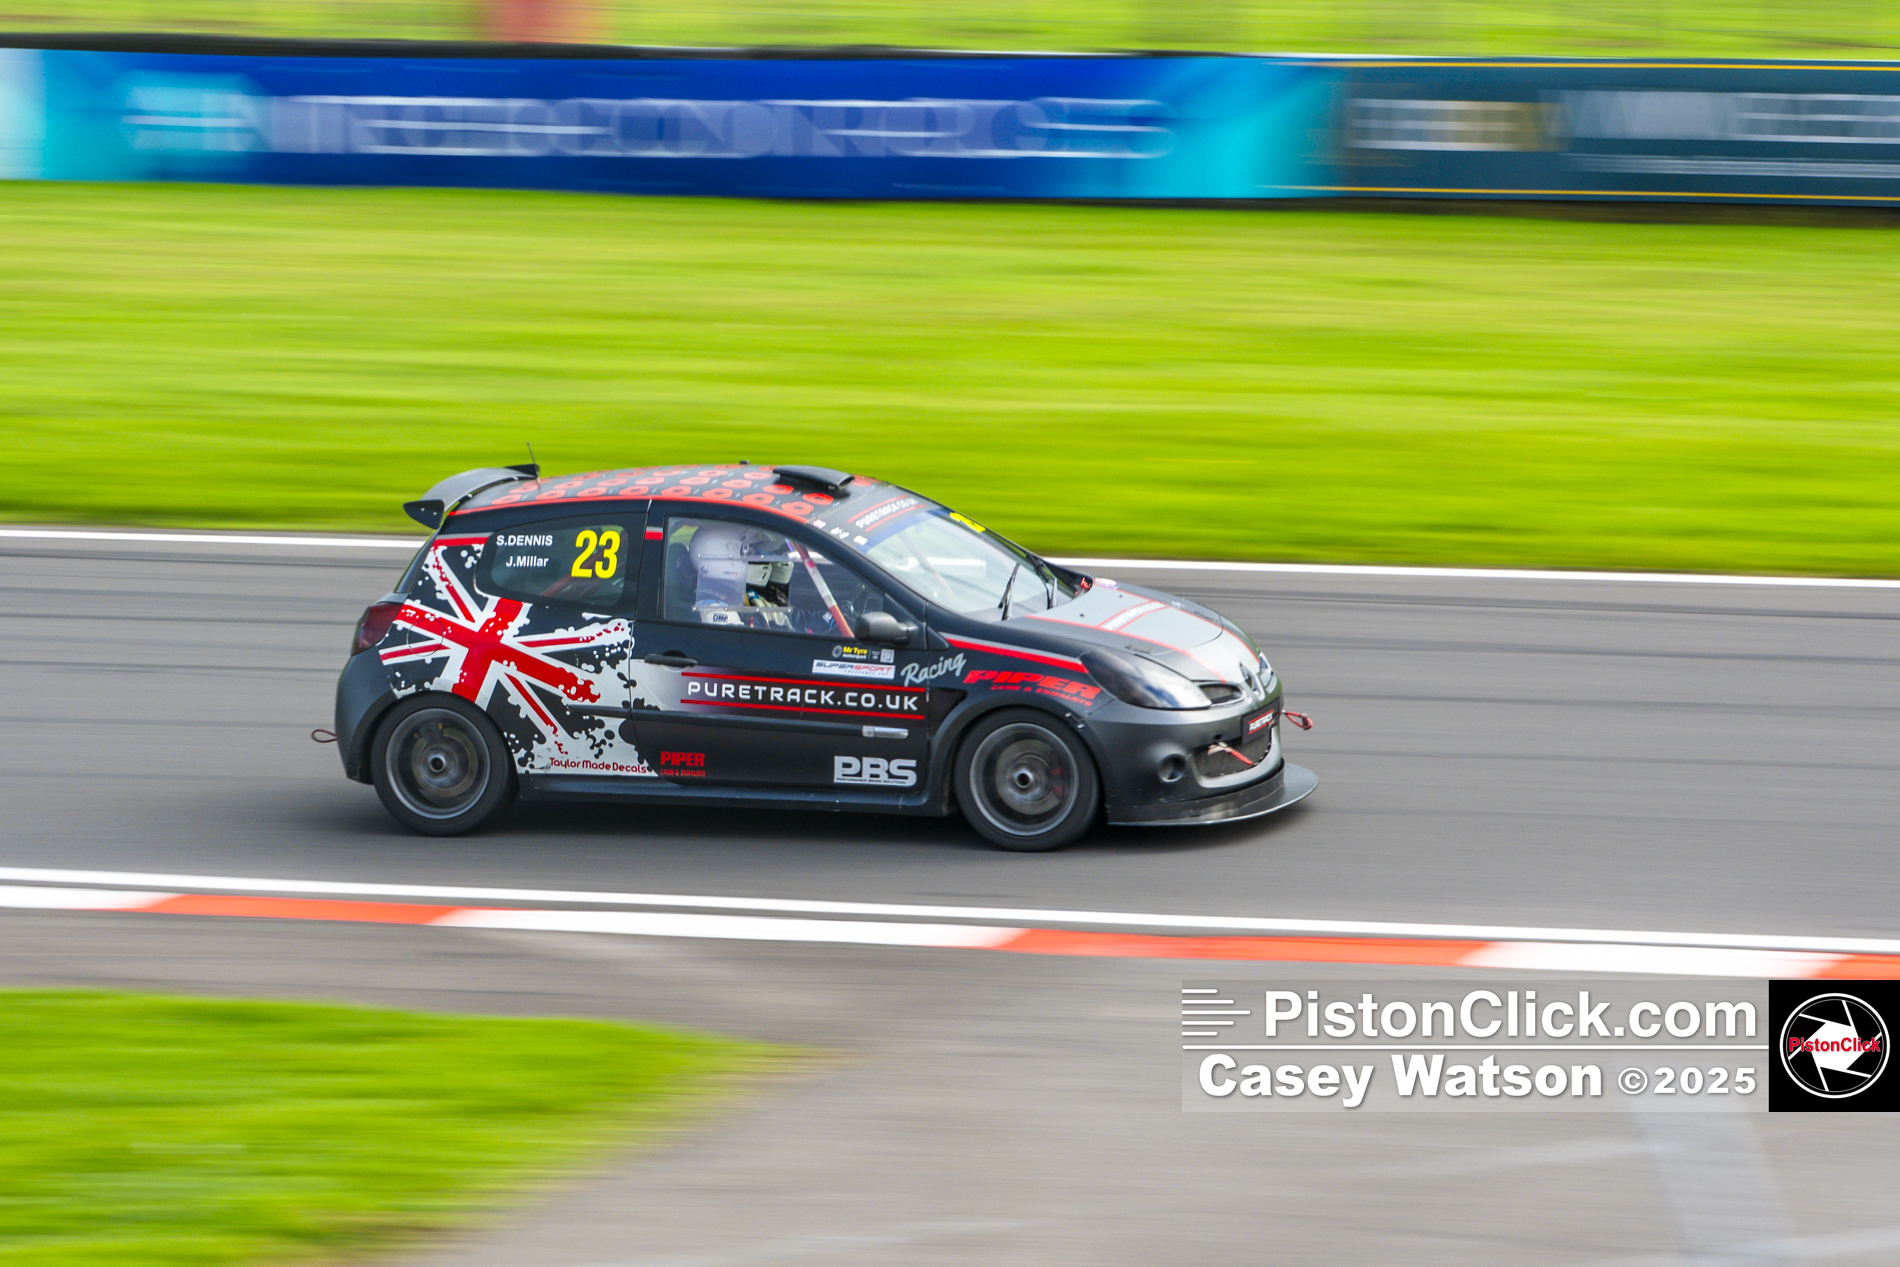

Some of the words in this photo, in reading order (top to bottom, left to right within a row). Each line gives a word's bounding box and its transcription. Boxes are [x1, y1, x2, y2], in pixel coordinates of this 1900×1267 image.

[496, 534, 553, 547] S.DENNIS
[505, 556, 549, 567] J.Millar
[571, 530, 621, 579] 23
[853, 647, 868, 655] Tyre
[815, 661, 893, 673] SUPERSPORT
[900, 652, 967, 688] Racing
[963, 670, 1102, 700] PIPER
[687, 681, 919, 712] PURETRACK.CO.UK
[549, 757, 581, 769] Taylor
[582, 760, 611, 771] Made
[612, 762, 647, 774] Decals
[660, 751, 705, 767] PIPER
[833, 755, 918, 787] PBS
